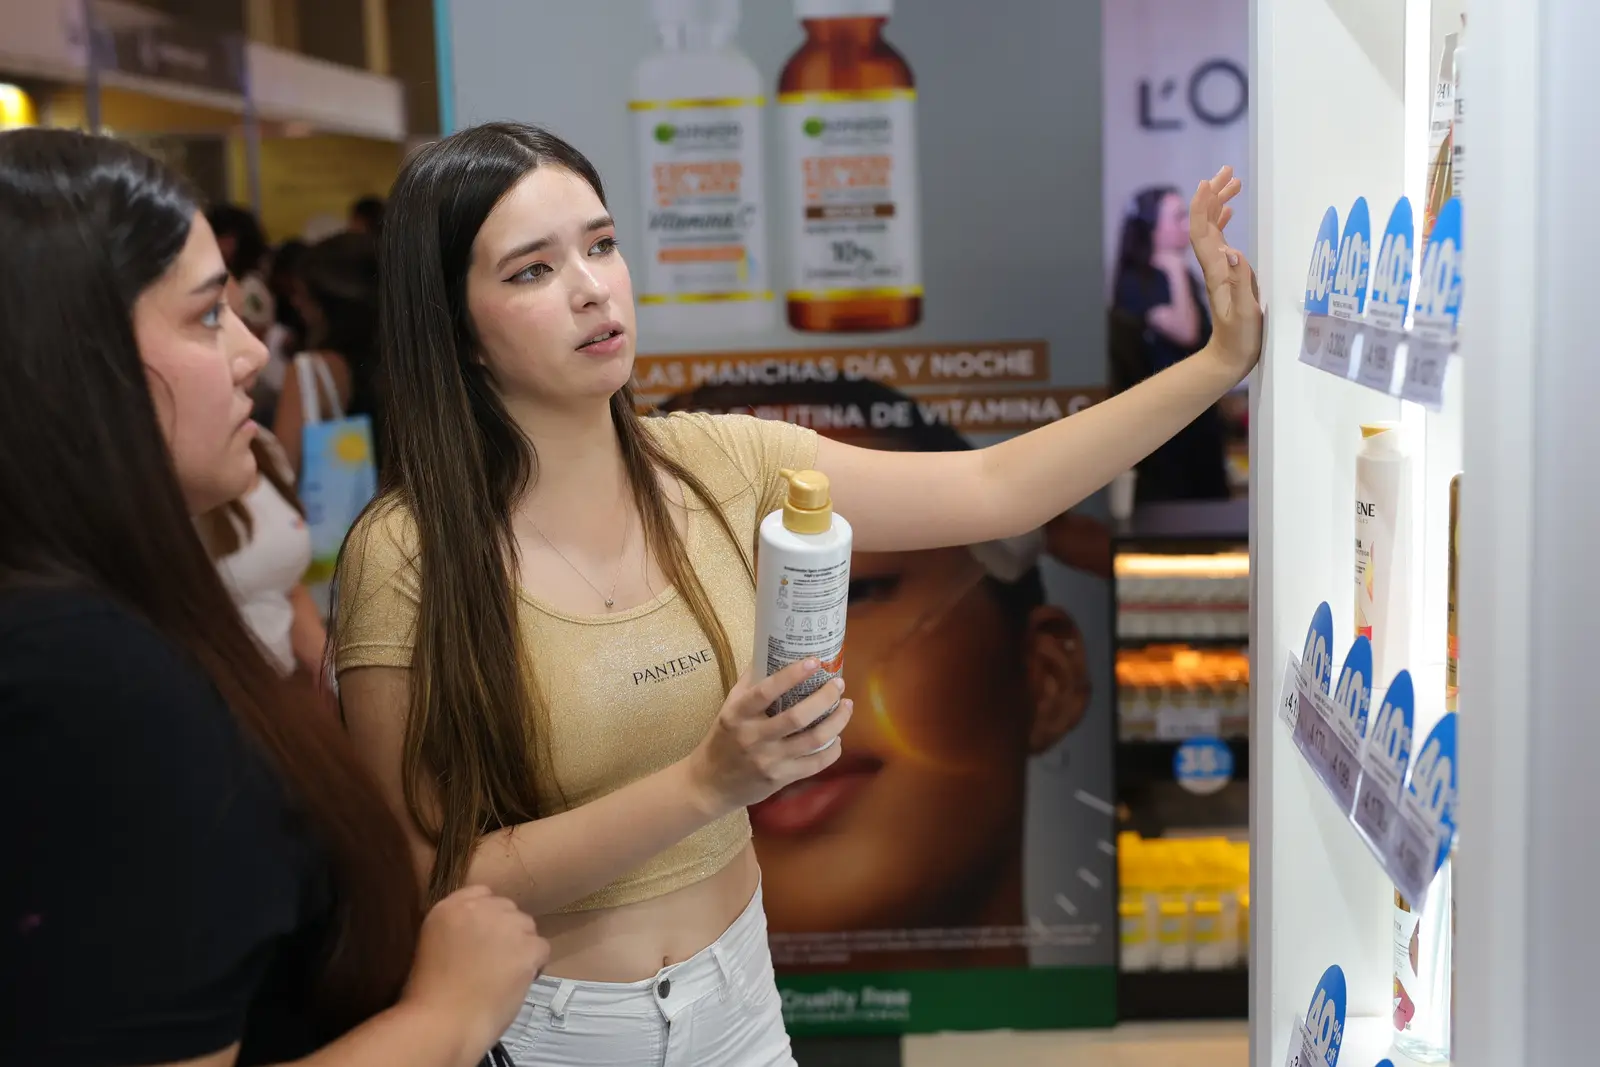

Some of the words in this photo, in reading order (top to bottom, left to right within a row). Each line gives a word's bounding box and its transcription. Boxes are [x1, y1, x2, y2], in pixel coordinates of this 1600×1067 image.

[691, 354, 839, 386] MANCHAS
[843, 347, 895, 379] DÍA
[904, 352, 924, 376] Y
[931, 349, 1034, 378] NOCHE
[868, 404, 909, 429] DE
[919, 395, 1059, 427] VITAMINA
[1356, 500, 1376, 518] ENE
[633, 648, 712, 686] PANTENE
